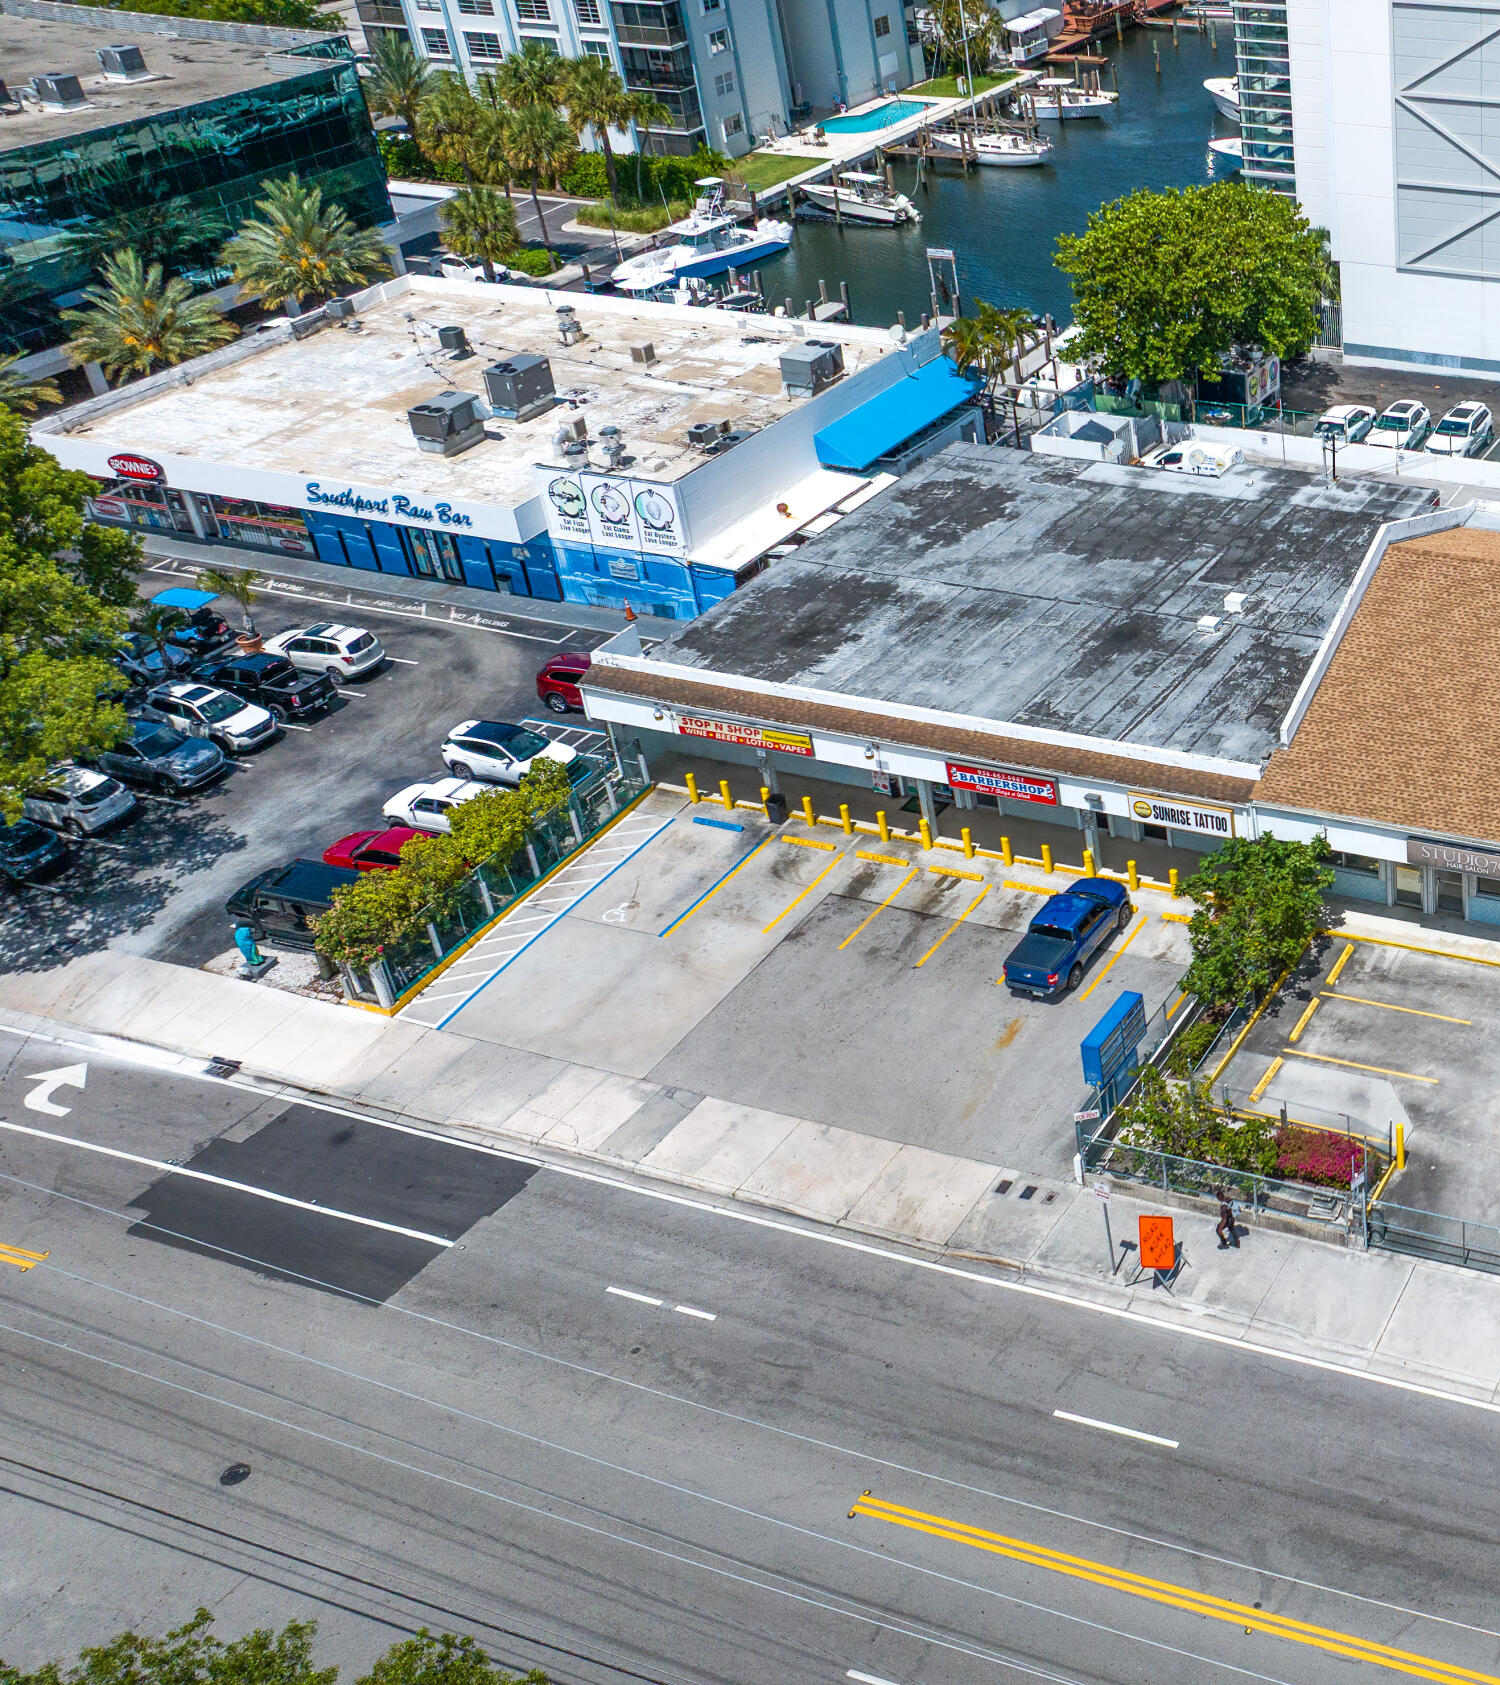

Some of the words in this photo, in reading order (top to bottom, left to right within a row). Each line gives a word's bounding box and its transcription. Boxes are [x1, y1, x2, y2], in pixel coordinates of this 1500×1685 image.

[109, 458, 158, 476] BROWNIE'S
[306, 482, 389, 514] Southport
[392, 495, 434, 520] Raw
[435, 502, 473, 526] Bar
[468, 613, 510, 628] PARKING
[681, 717, 711, 728] STOP
[714, 721, 723, 731] N
[727, 724, 761, 739] SHOP
[684, 727, 708, 737] WINE
[715, 732, 738, 743] BEER
[746, 737, 774, 748] LOTTO
[779, 744, 807, 754] VAPES
[959, 772, 1045, 795] BARBERSHOP
[975, 784, 989, 792] Open
[995, 788, 1011, 796] Days
[1017, 791, 1031, 799] Week
[1152, 804, 1191, 826] SUNRISE
[1193, 812, 1228, 832] TATTOO
[1446, 861, 1463, 869] HAIR
[1464, 864, 1489, 874] SALON
[1142, 1221, 1158, 1242] ROAD
[1149, 1232, 1164, 1252] WORK
[1154, 1238, 1171, 1263] AHEAD
